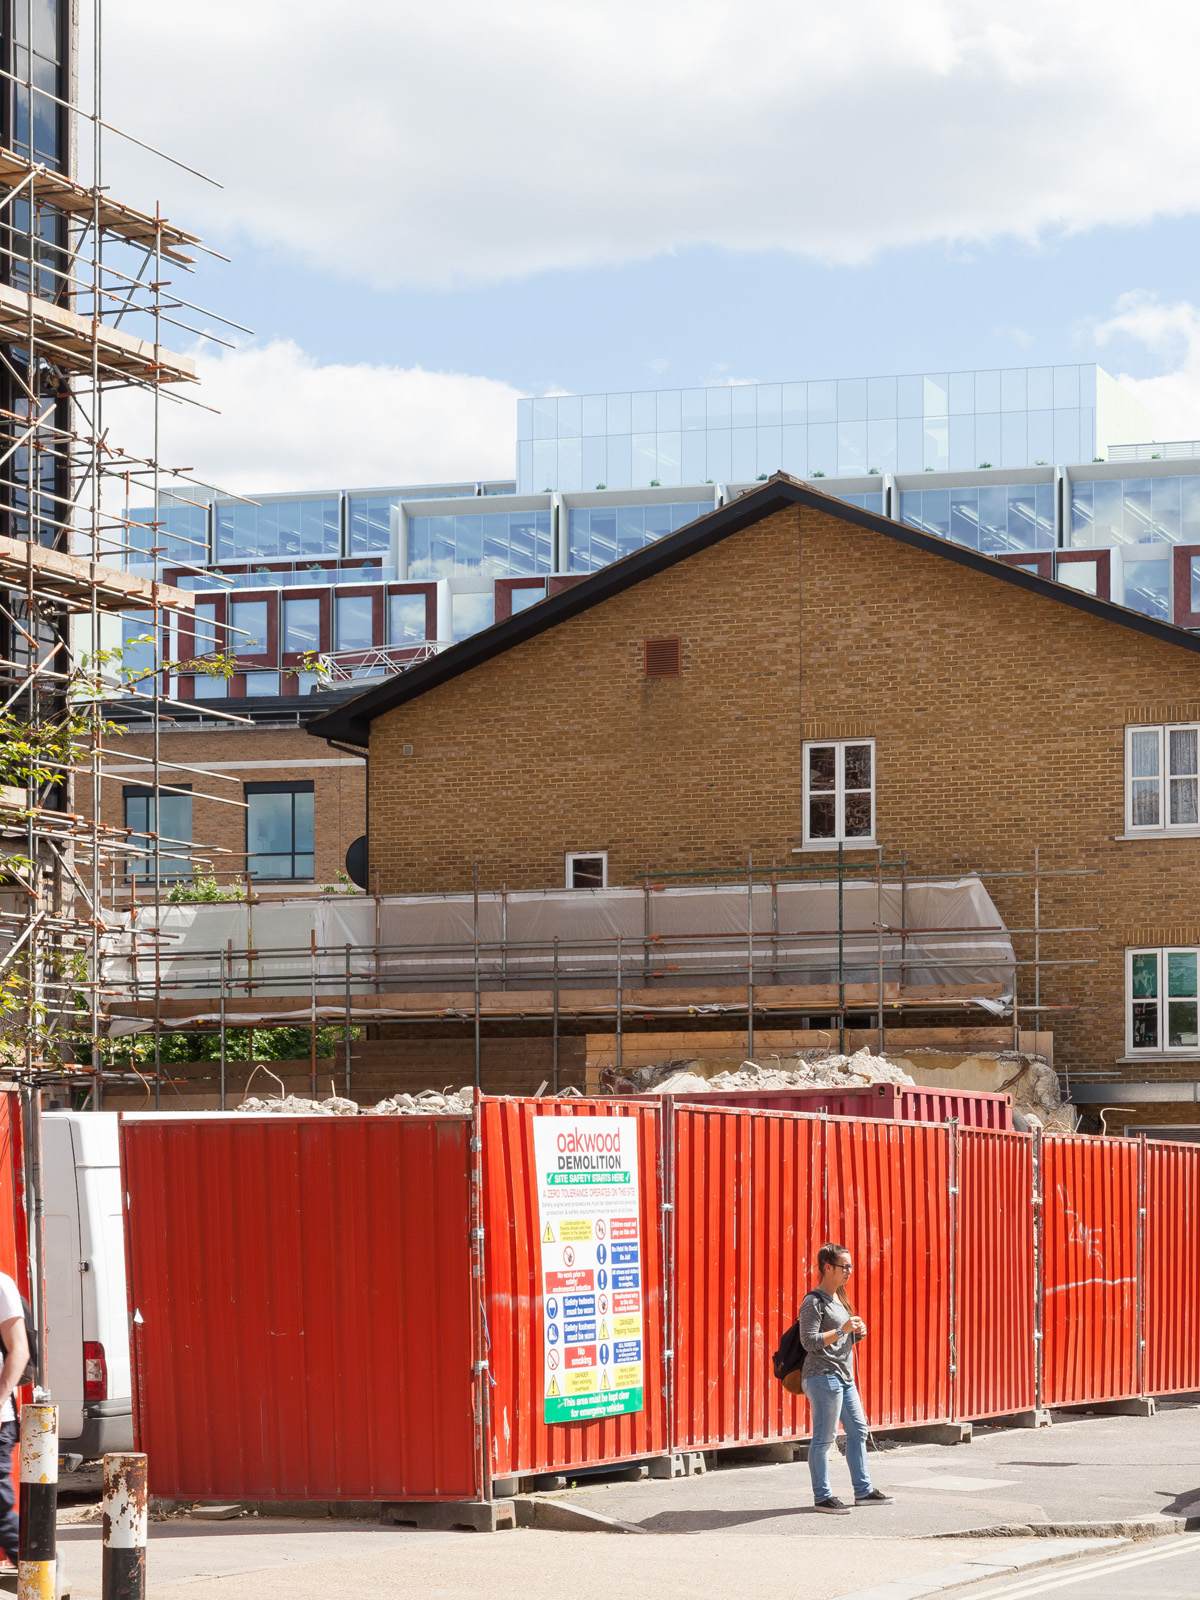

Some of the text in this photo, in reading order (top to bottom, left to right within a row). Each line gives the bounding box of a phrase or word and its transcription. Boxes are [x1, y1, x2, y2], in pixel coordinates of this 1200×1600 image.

[557, 1127, 620, 1153] oakwood
[558, 1155, 621, 1170] DEMOLITION
[554, 1173, 624, 1183] SITE SAFETY STARTS HERE
[548, 1190, 560, 1198] ZERO
[561, 1189, 588, 1198] TOLERANCE
[590, 1188, 610, 1197] OPERATES
[612, 1188, 618, 1196] ON
[565, 1299, 578, 1307] Safety
[565, 1324, 578, 1332] Safety
[578, 1347, 585, 1355] No
[572, 1356, 592, 1366] smoking
[563, 1398, 575, 1407] This
[576, 1398, 588, 1406] area
[589, 1395, 601, 1405] must
[608, 1393, 618, 1403] kept
[619, 1391, 630, 1400] clear
[570, 1403, 624, 1417] for emergency vehicles
